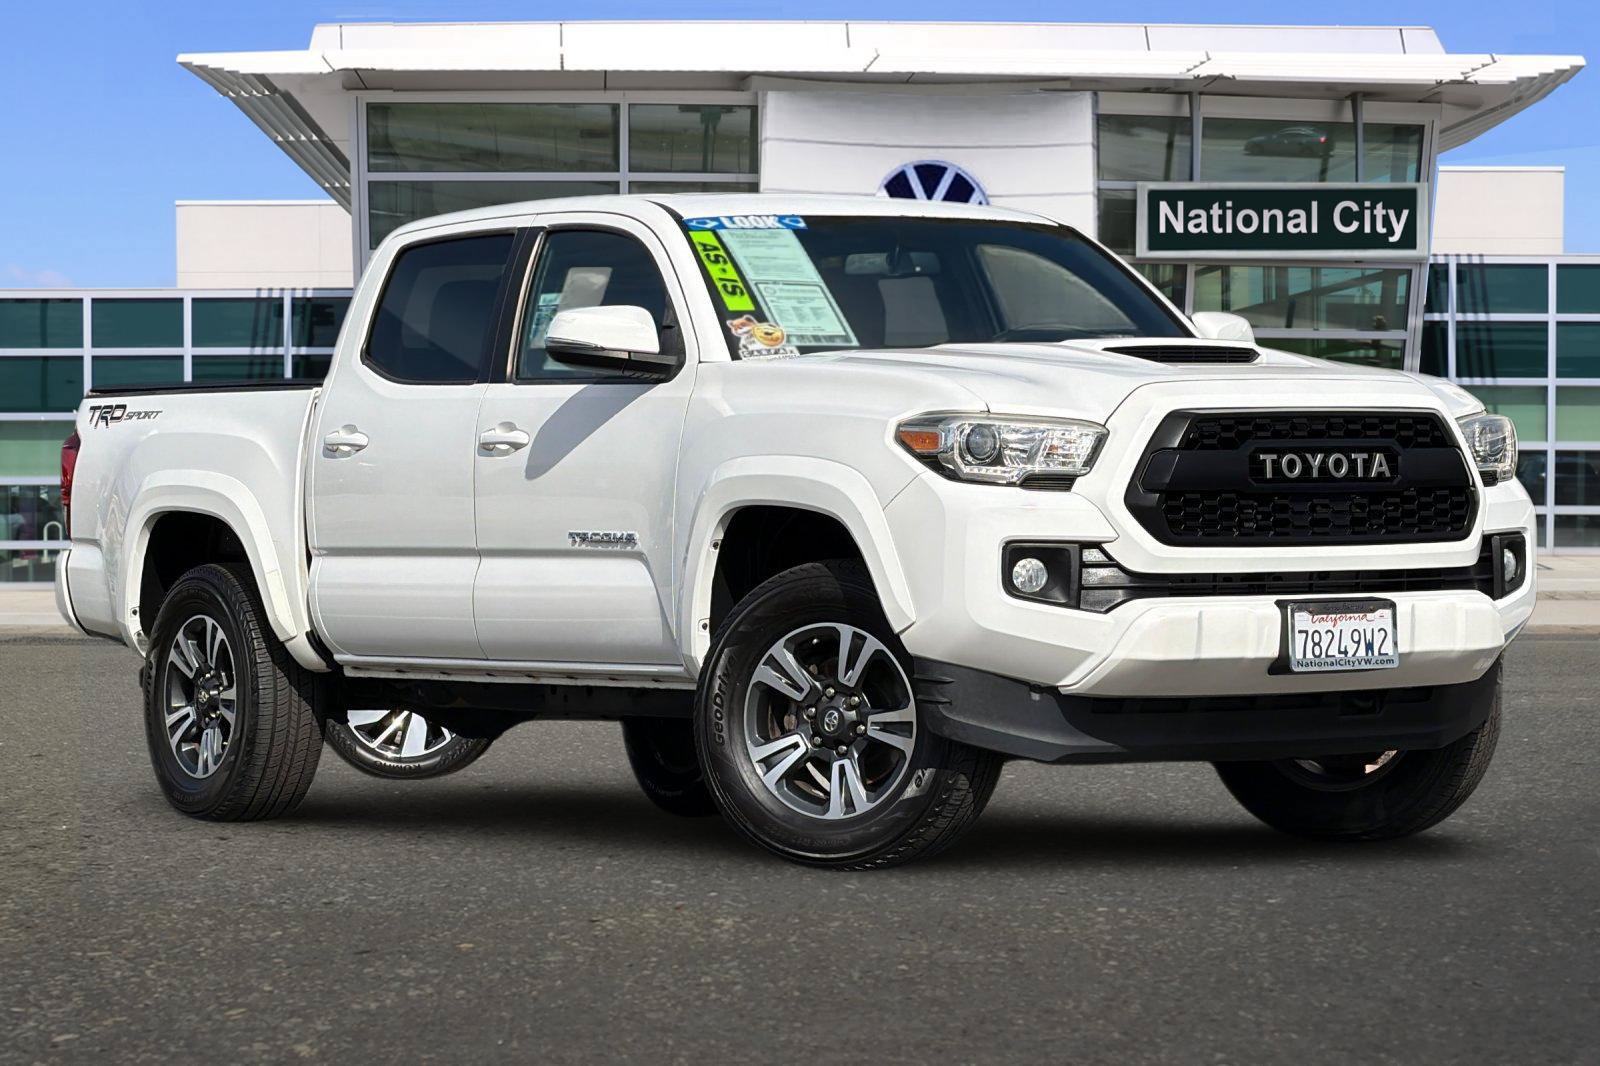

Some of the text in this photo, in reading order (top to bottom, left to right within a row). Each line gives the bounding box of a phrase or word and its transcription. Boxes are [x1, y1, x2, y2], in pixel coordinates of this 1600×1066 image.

[718, 215, 787, 229] LOOK
[1158, 200, 1410, 243] National City
[89, 404, 163, 429] TRD SPORT
[1259, 452, 1391, 479] TOYOTA
[567, 531, 639, 550] TACOMA
[1297, 627, 1389, 660] 78249W2
[1296, 658, 1396, 668] NationalCityVW.com
